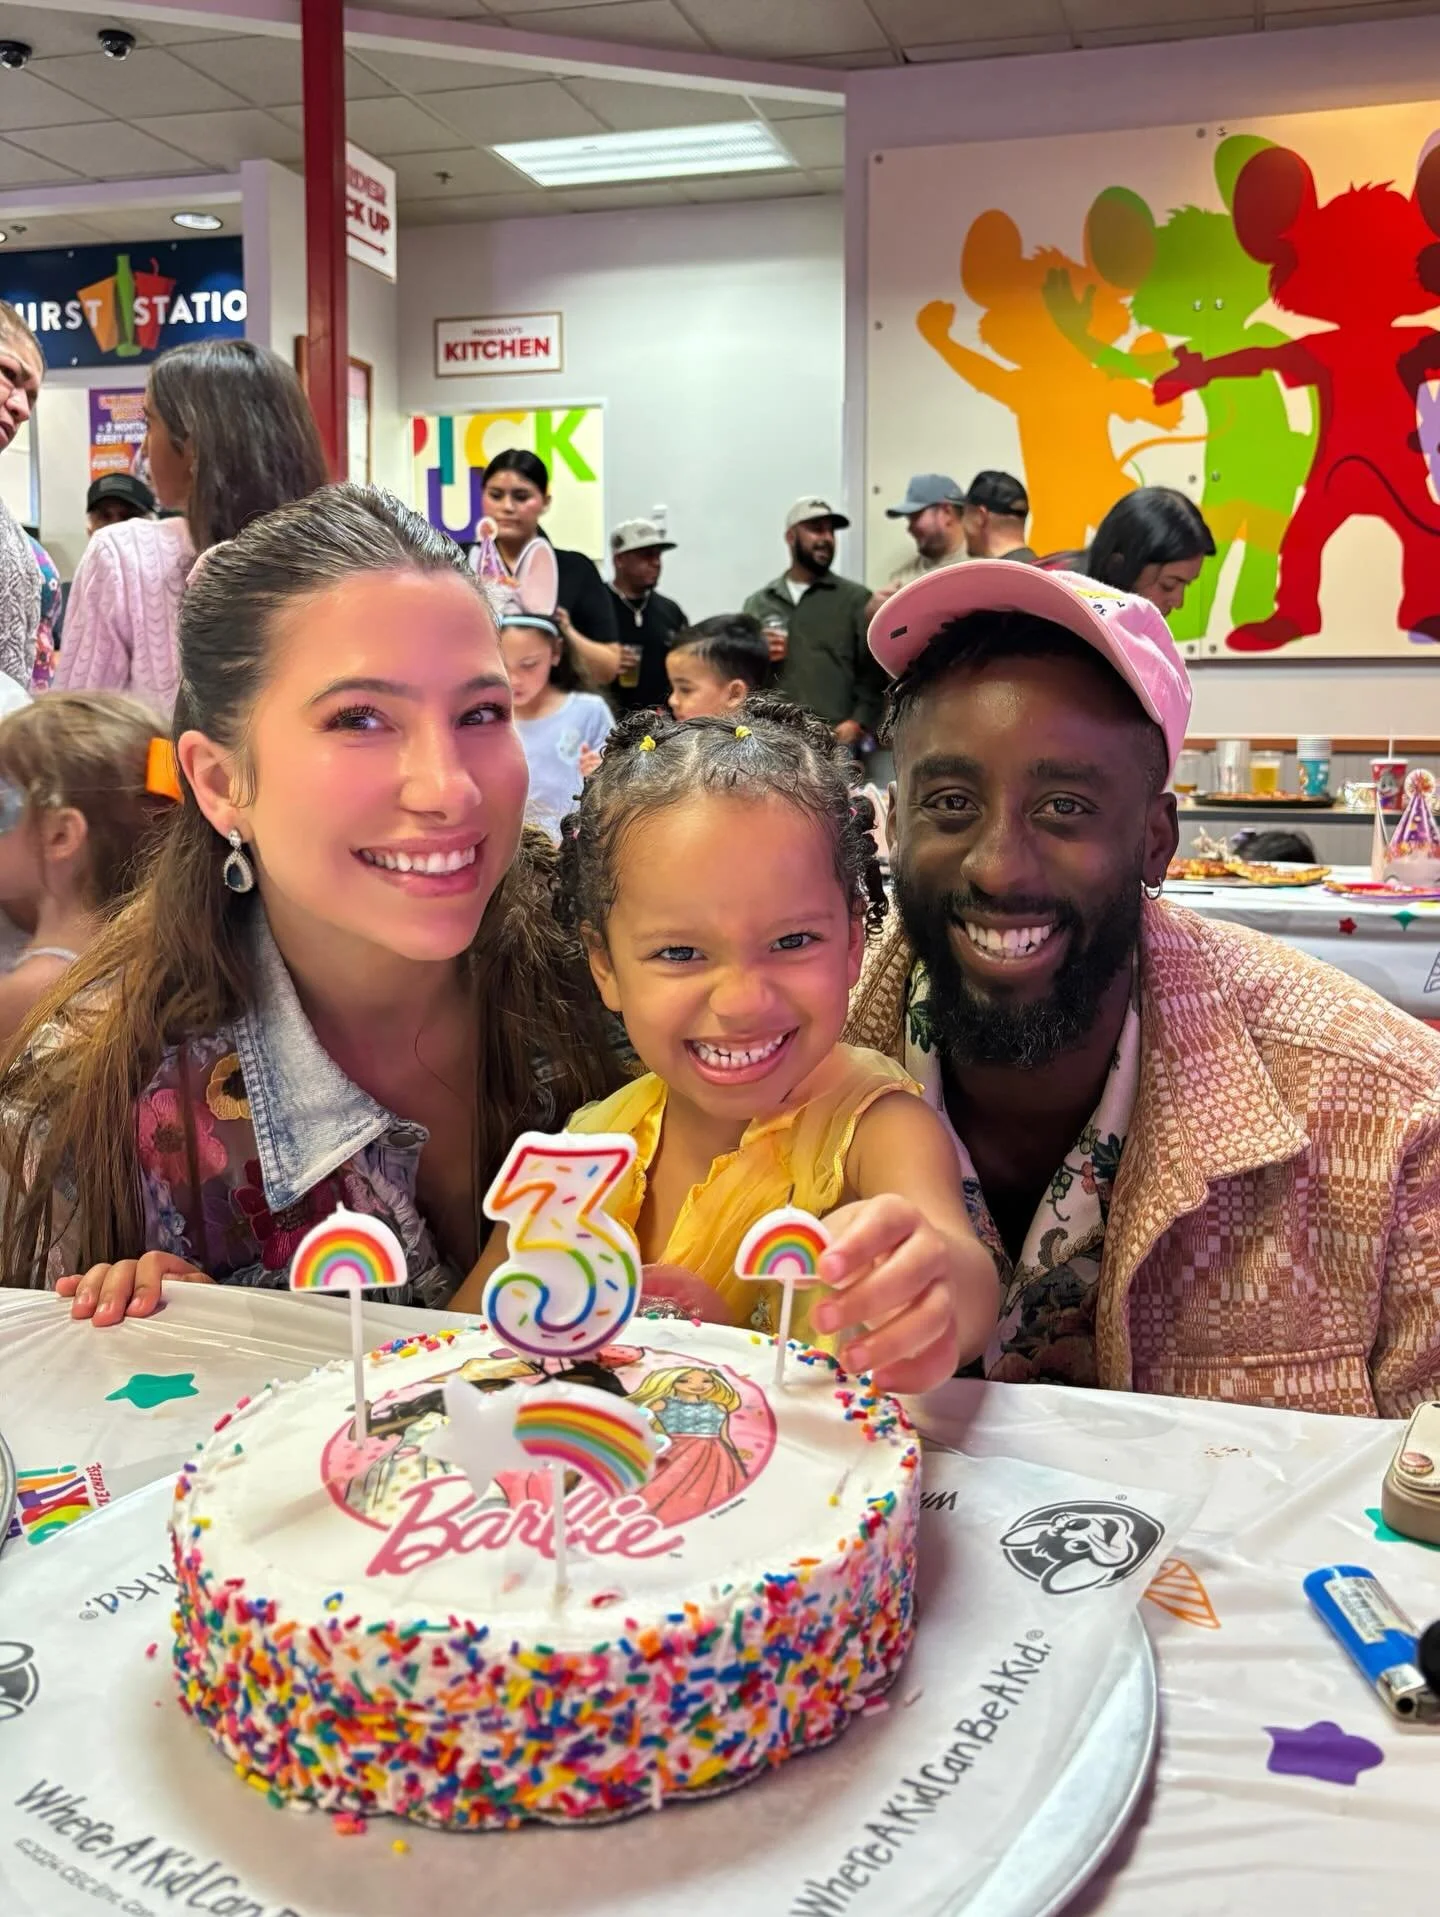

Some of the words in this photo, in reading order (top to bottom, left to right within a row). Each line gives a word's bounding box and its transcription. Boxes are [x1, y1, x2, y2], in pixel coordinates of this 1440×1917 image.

[367, 205, 390, 235] UP
[15, 298, 103, 331] IRST
[132, 289, 248, 326] STATIO
[444, 336, 550, 362] KITCHEN
[484, 1133, 642, 1360] 3
[366, 1475, 685, 1577] Barbie
